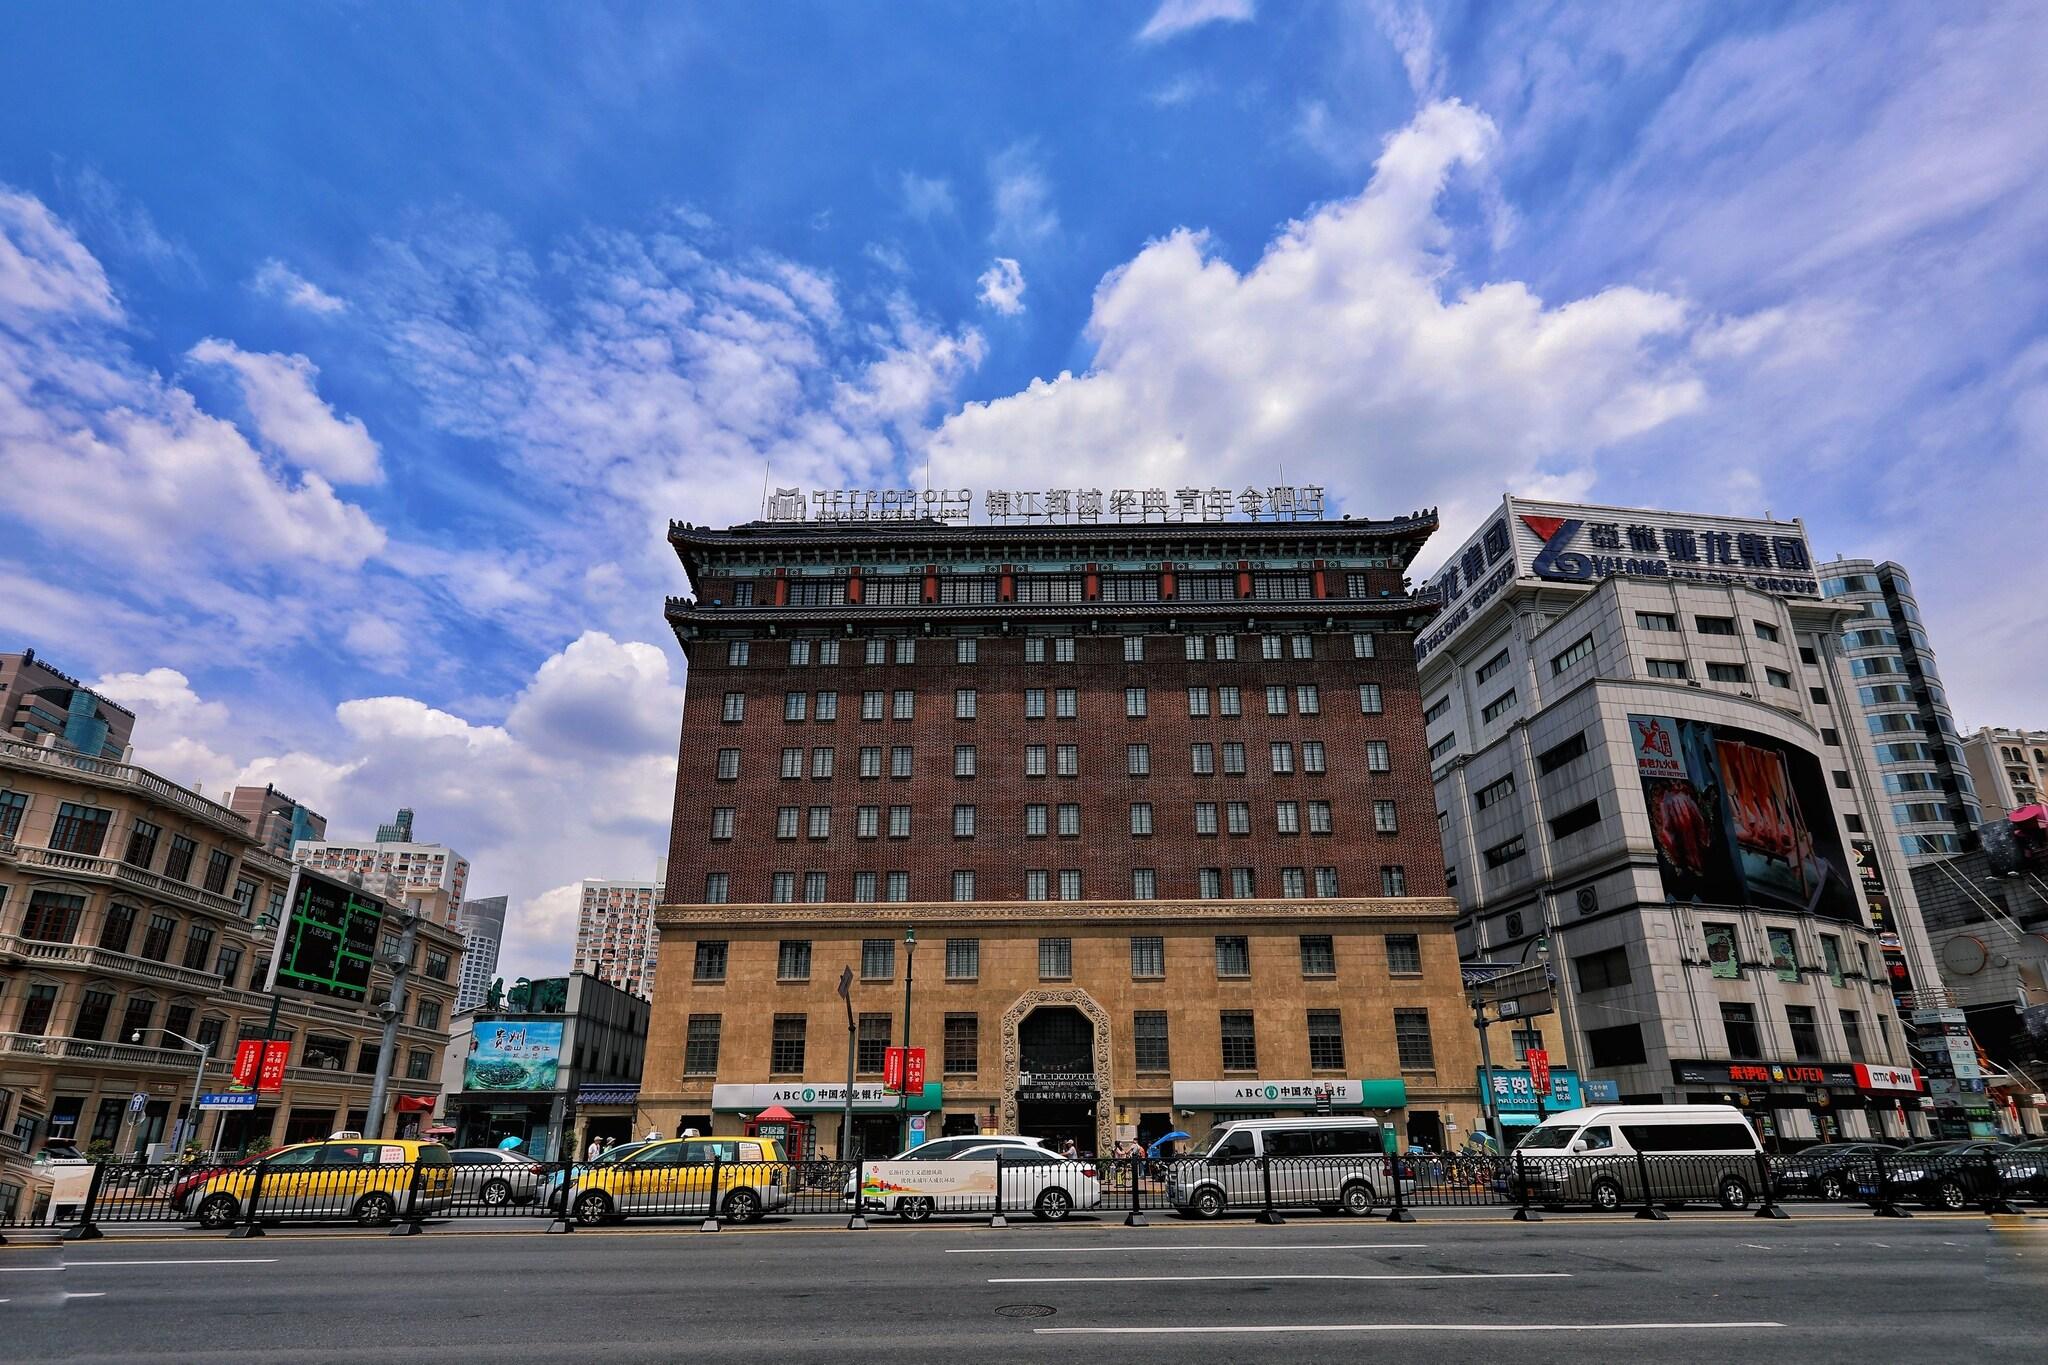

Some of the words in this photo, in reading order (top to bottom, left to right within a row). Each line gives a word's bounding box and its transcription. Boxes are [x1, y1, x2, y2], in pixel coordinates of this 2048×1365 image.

[812, 488, 972, 504] METROPOLO
[985, 484, 1325, 516] 锦江都城经典青年会酒店
[871, 509, 916, 519] HOTELS
[920, 509, 969, 519] CLASSIC
[1755, 575, 1819, 594] GROUP
[1424, 605, 1470, 653] YALONG
[1471, 557, 1516, 611] GROUP
[1786, 1066, 1825, 1084] LYFEN
[1872, 1071, 1889, 1083] CITIC
[773, 1090, 801, 1100] ABC
[818, 1089, 882, 1100] 中国农业银行
[1235, 1088, 1263, 1098] ABC
[759, 1126, 785, 1135] 安居客
